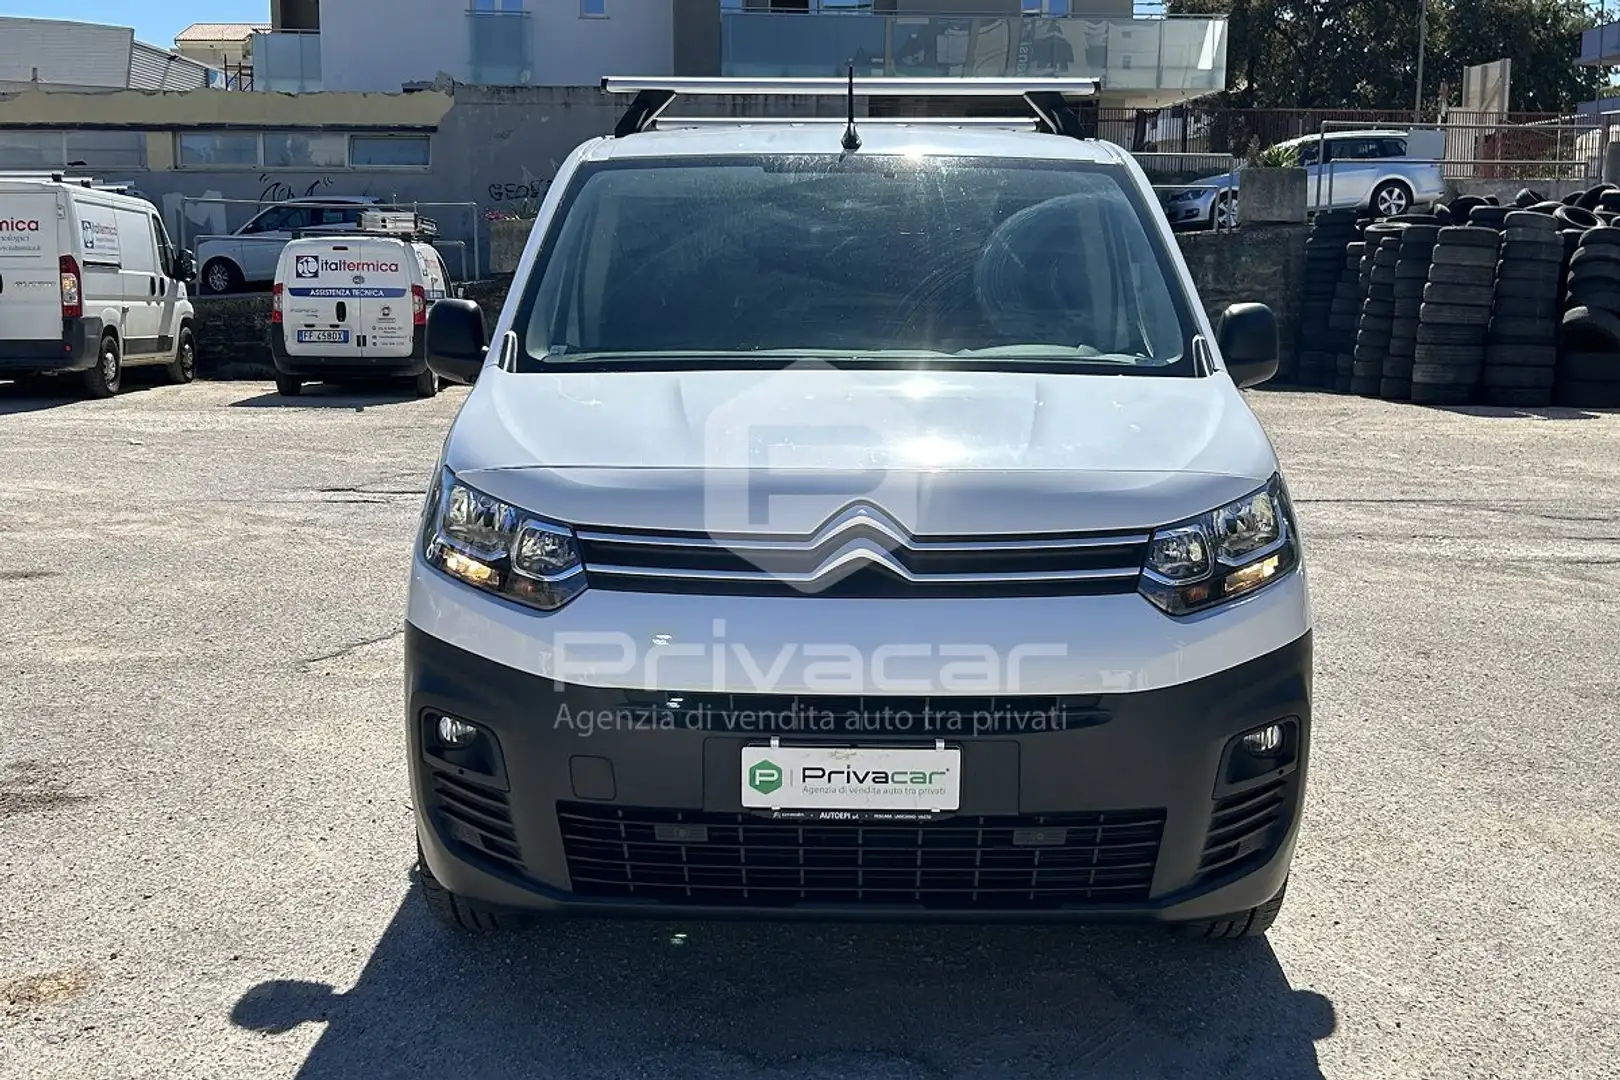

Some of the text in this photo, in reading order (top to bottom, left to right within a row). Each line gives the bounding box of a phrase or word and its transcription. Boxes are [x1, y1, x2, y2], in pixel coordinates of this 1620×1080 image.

[320, 259, 399, 272] italtermica
[802, 764, 946, 784] Privacar
[802, 785, 946, 797] Agenzia di vendita auto tra privati
[819, 811, 851, 820] AUTOEPI
